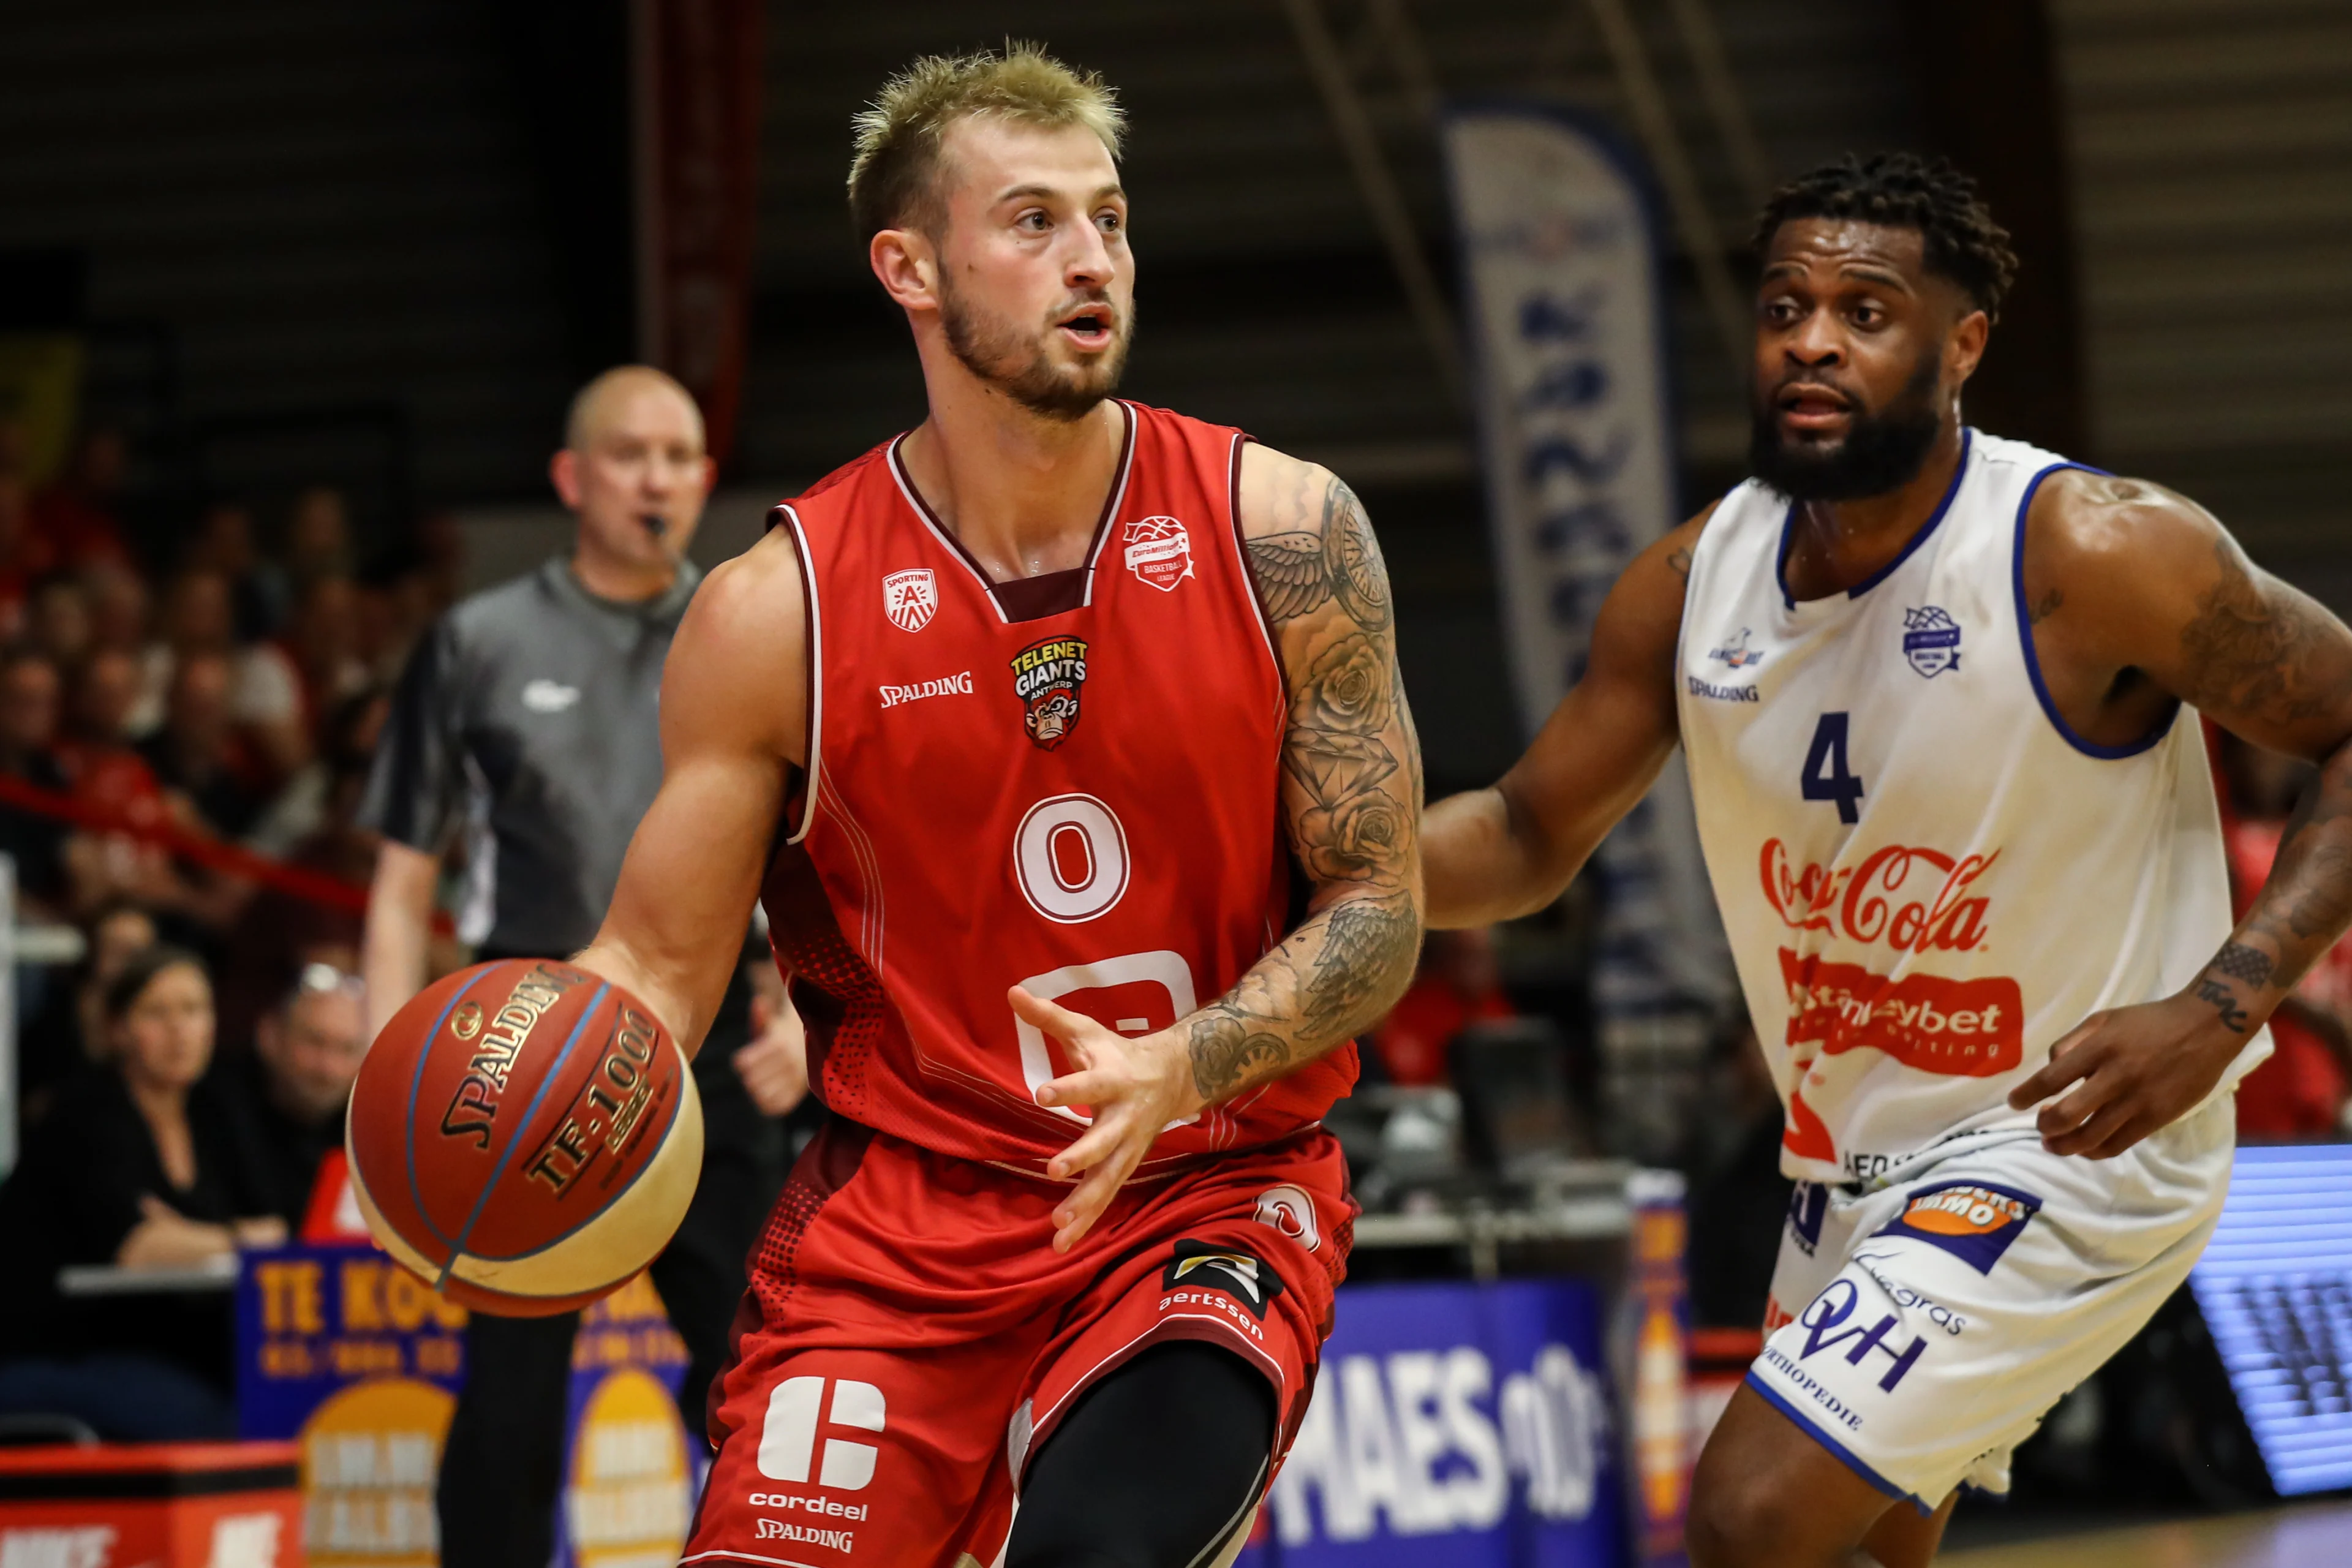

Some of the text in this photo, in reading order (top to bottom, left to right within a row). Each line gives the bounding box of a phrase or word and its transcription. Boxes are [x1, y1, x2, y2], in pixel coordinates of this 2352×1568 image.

[887, 574, 929, 589] SPORTING
[1144, 560, 1183, 574] BASKETBALL
[1011, 641, 1088, 676] TELENET
[879, 671, 973, 709] SPALDING
[1015, 659, 1087, 696] GIANTS
[1030, 680, 1073, 701] ANTWERP
[1688, 675, 1760, 703] SPALDING
[1801, 710, 1864, 825] 4
[1012, 792, 1131, 924] 0
[440, 962, 587, 1152] SPALDING
[525, 1009, 656, 1193] TF-1000
[1159, 1292, 1264, 1341] aertssen
[1762, 1345, 1864, 1431] ORTHOPEDIE
[1275, 1345, 1510, 1546] MAES
[748, 1492, 869, 1522] cordeel
[755, 1517, 853, 1554] SPALDING
